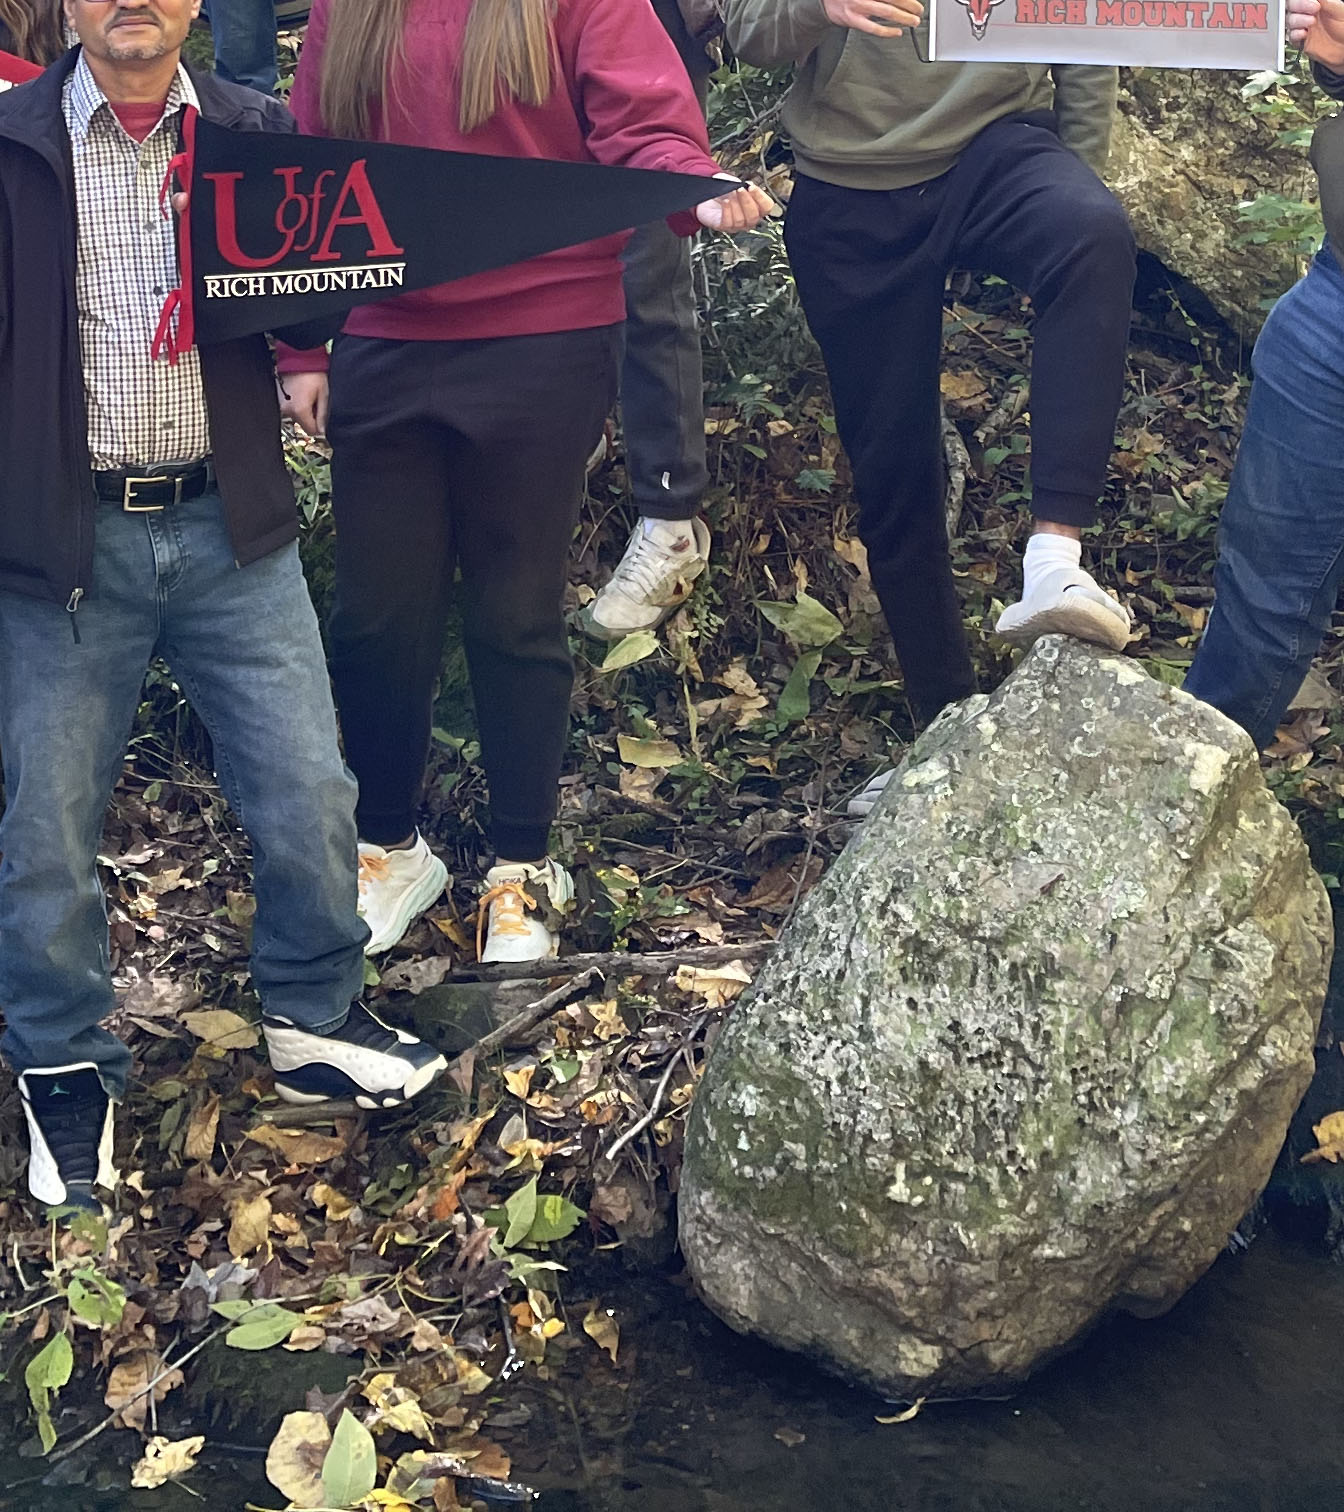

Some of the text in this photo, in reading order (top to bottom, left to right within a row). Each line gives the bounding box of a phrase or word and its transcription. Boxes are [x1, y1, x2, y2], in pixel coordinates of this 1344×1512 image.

[1095, 0, 1269, 30] MOUNTAIN
[206, 266, 406, 299] RICH MOUNTAIN
